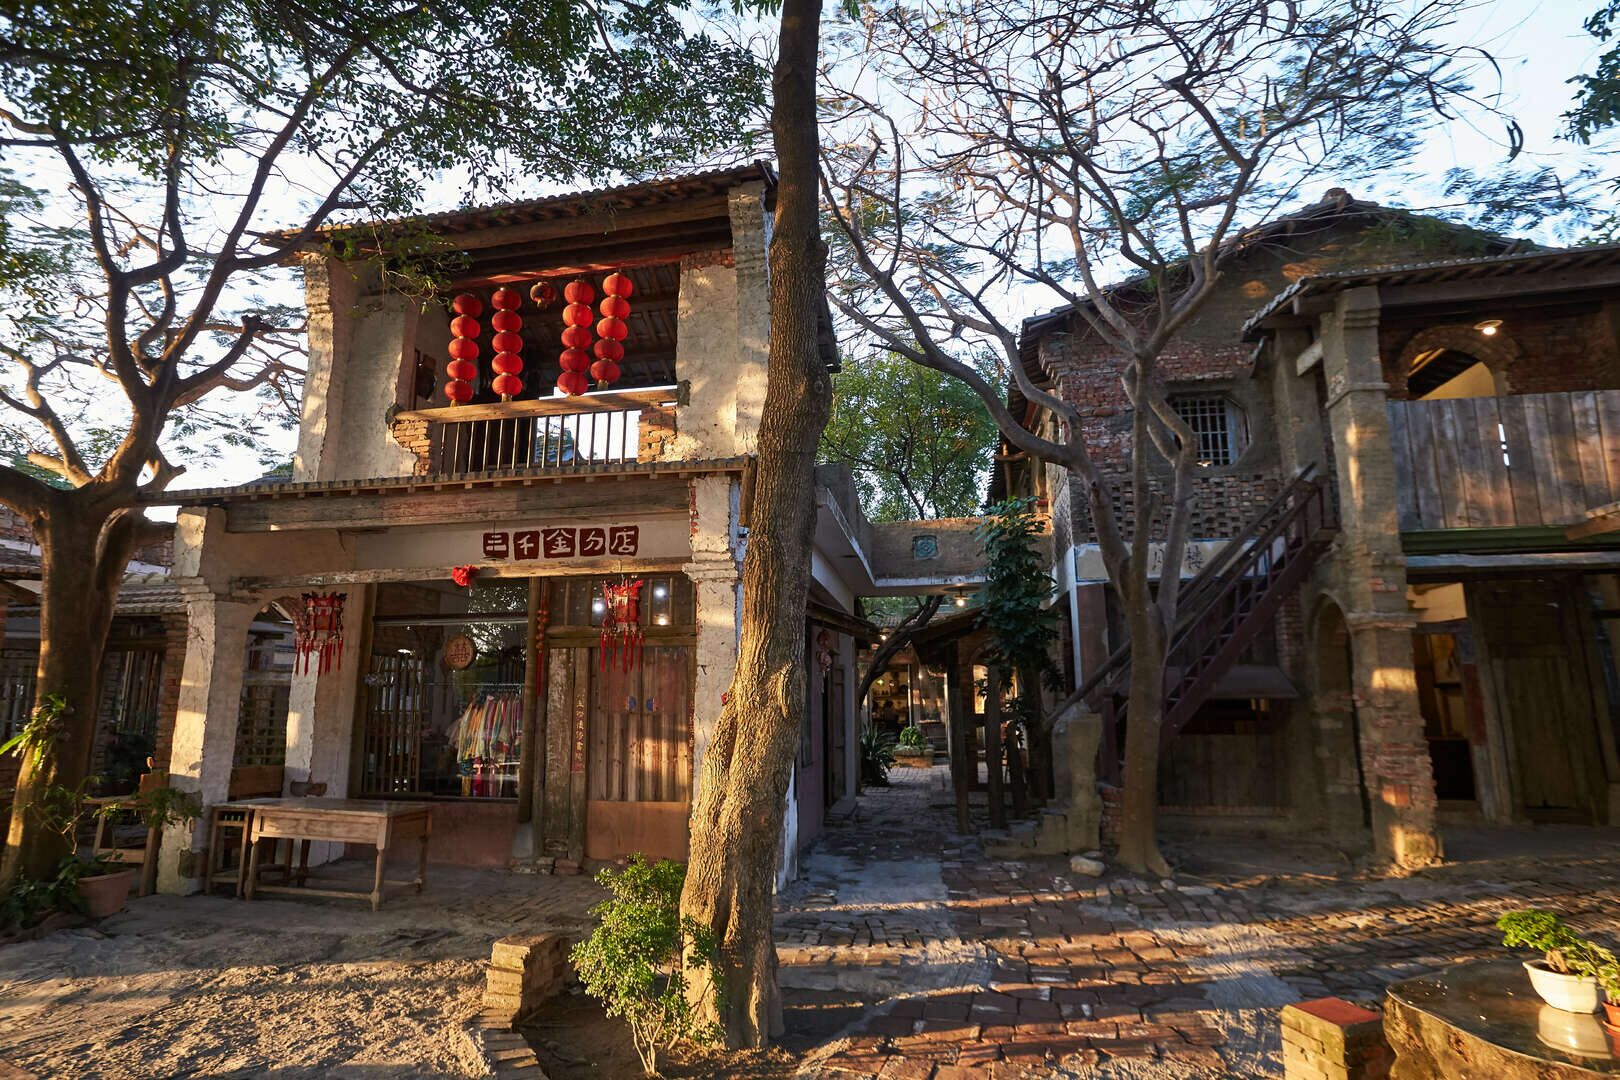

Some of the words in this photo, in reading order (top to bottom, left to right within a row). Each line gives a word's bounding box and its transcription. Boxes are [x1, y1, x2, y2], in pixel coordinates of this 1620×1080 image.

[485, 527, 637, 558] 三千金分店
